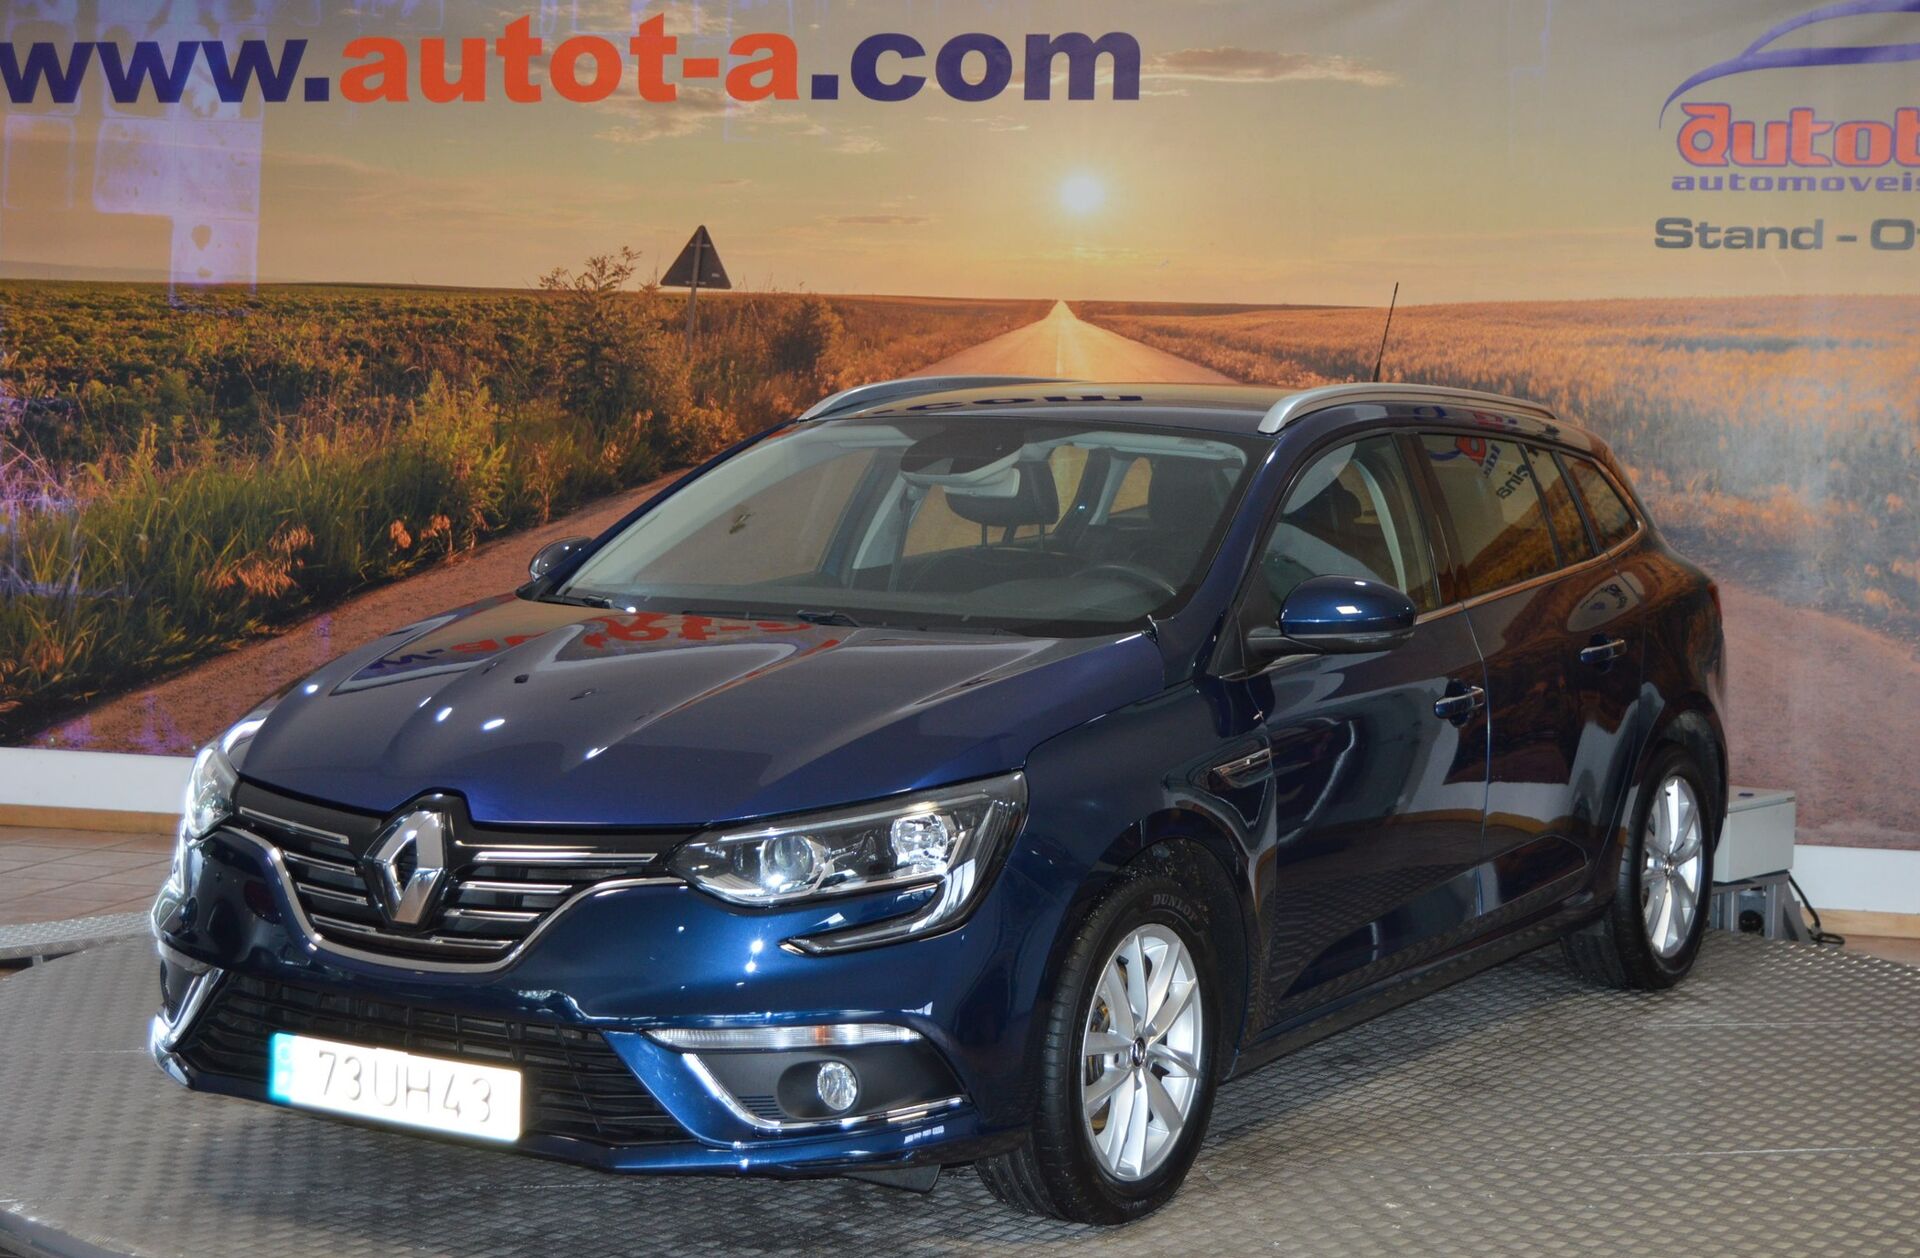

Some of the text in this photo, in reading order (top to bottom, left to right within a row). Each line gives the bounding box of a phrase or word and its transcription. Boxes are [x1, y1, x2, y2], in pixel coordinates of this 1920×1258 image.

[0, 13, 1141, 103] www.autot-a.com
[1671, 172, 1920, 192] automovei
[1654, 217, 1824, 250] Stand
